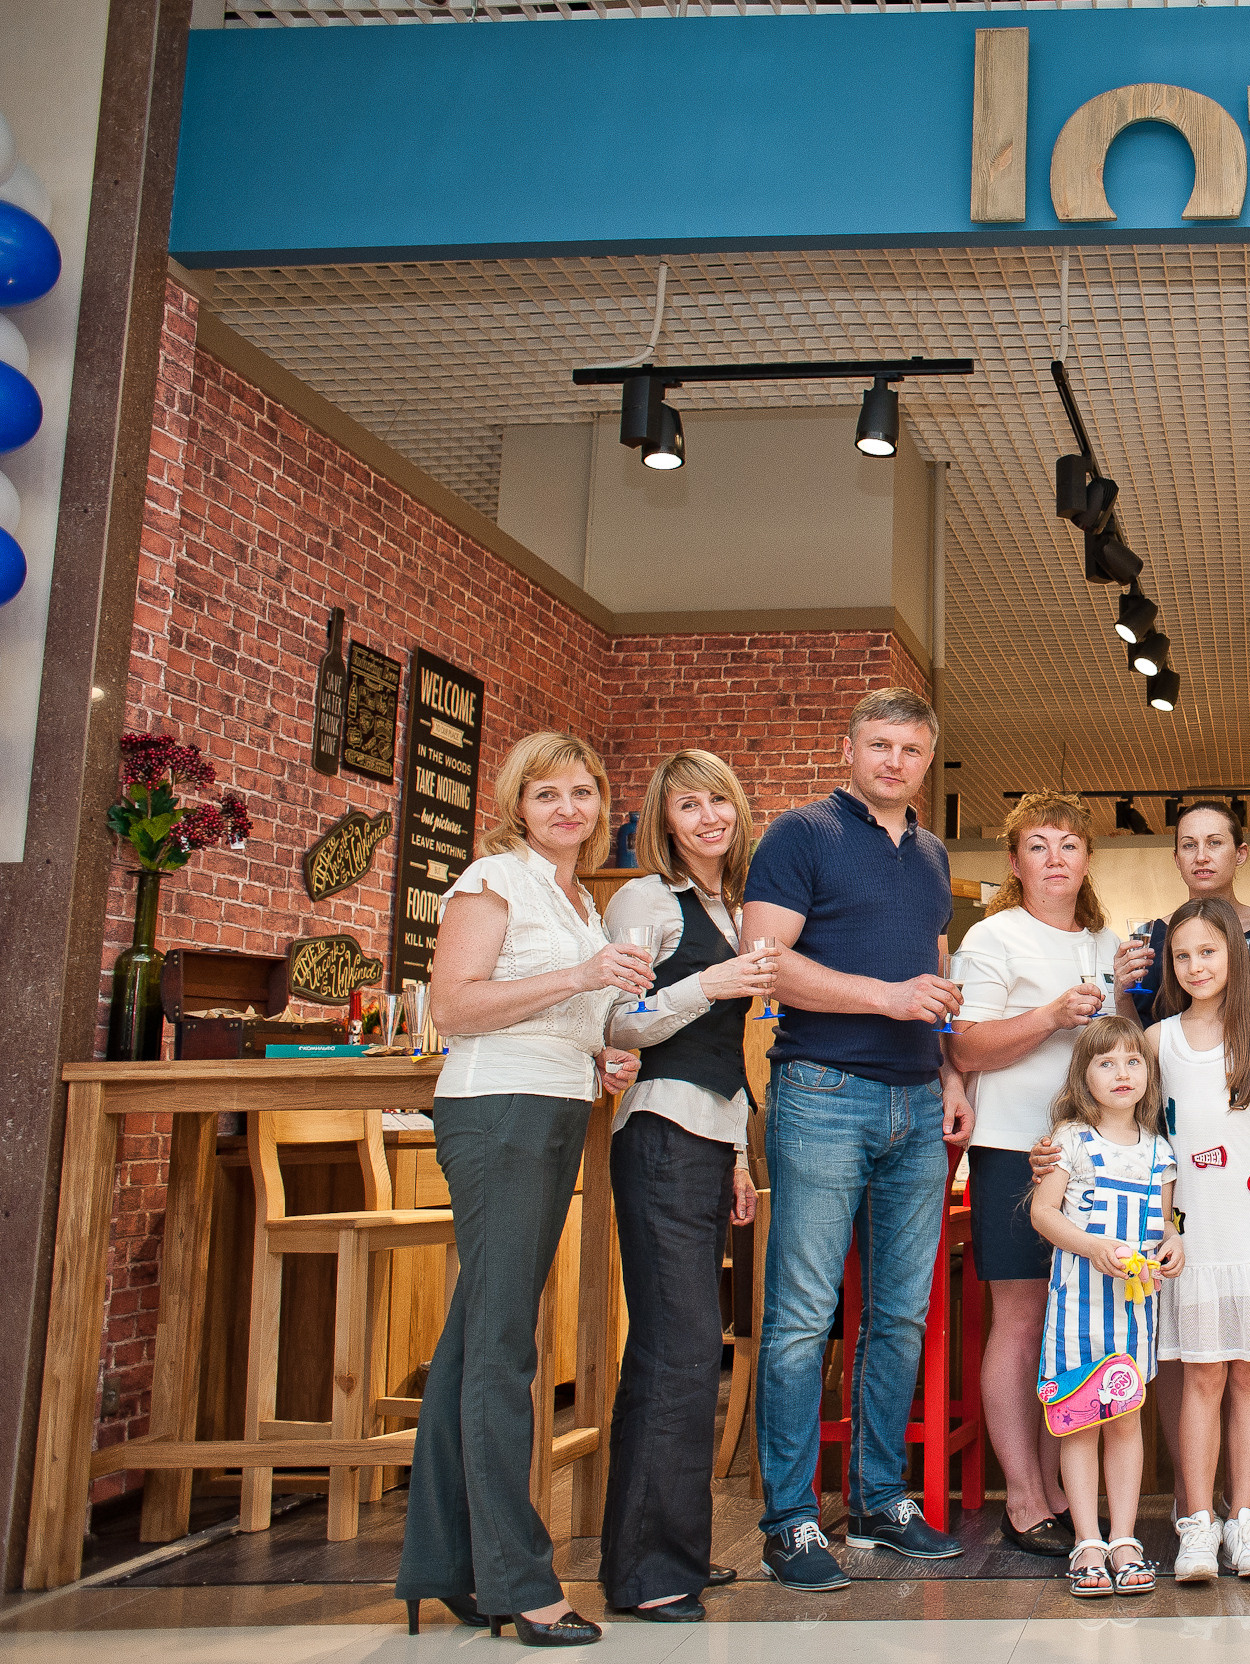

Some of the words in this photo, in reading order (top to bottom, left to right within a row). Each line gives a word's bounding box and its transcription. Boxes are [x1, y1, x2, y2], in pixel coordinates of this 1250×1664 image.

[421, 666, 477, 728] WELCOME
[417, 743, 427, 758] IN
[428, 747, 444, 765] THE
[445, 754, 472, 776] WOODS
[416, 765, 436, 798] TAKE
[436, 773, 471, 810] NOTHING
[420, 807, 434, 826] but
[432, 813, 462, 835] pictures
[411, 833, 435, 851] LEAVE
[435, 840, 467, 860] NOTHING
[406, 886, 441, 925] FOOTP
[404, 931, 424, 948] KILL
[1194, 1149, 1222, 1165] CHEER
